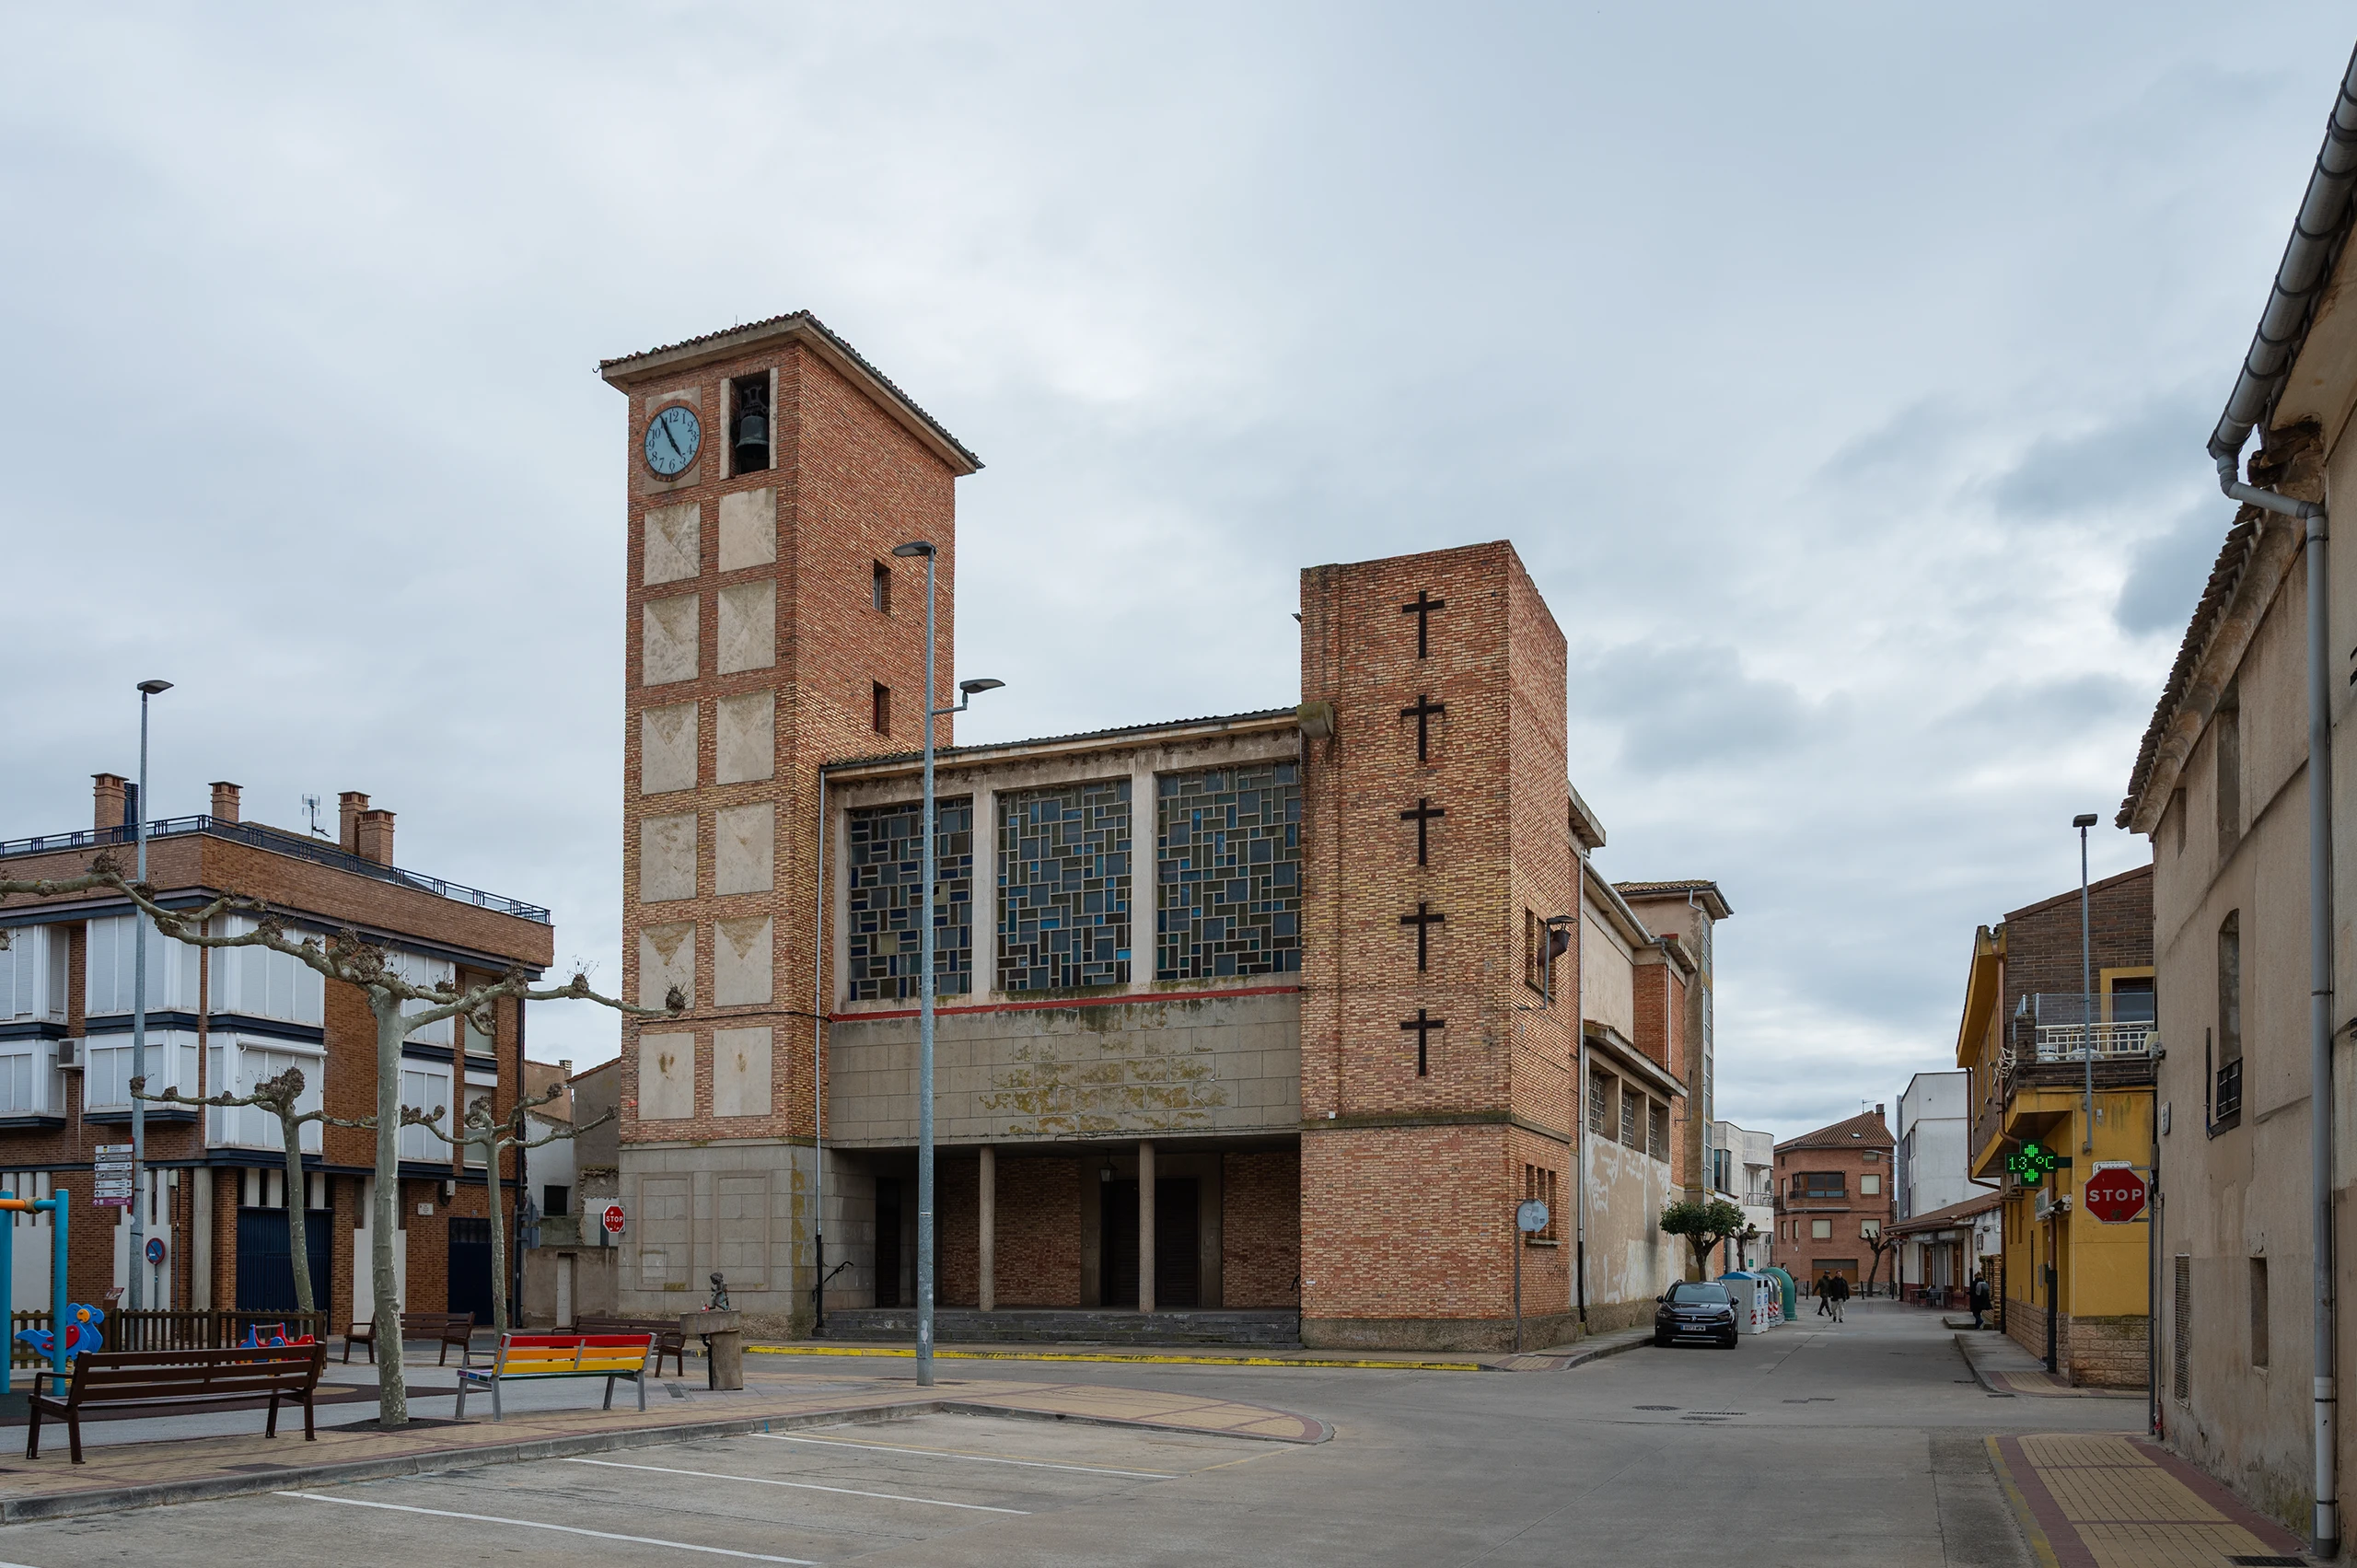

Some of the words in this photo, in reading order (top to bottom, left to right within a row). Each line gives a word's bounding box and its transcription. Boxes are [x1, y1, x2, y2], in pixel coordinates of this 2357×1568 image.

[669, 411, 679, 423] 12
[682, 412, 686, 424] 1
[687, 421, 693, 433] 2
[652, 427, 661, 440] 10
[691, 430, 697, 442] 3
[648, 439, 655, 451] 9
[687, 444, 693, 455] 4
[652, 451, 657, 462] 8
[679, 452, 686, 464] 5
[658, 457, 665, 471] 7
[668, 459, 675, 470] 6
[2009, 1156, 2027, 1170] 13
[2088, 1189, 2142, 1202] STOP
